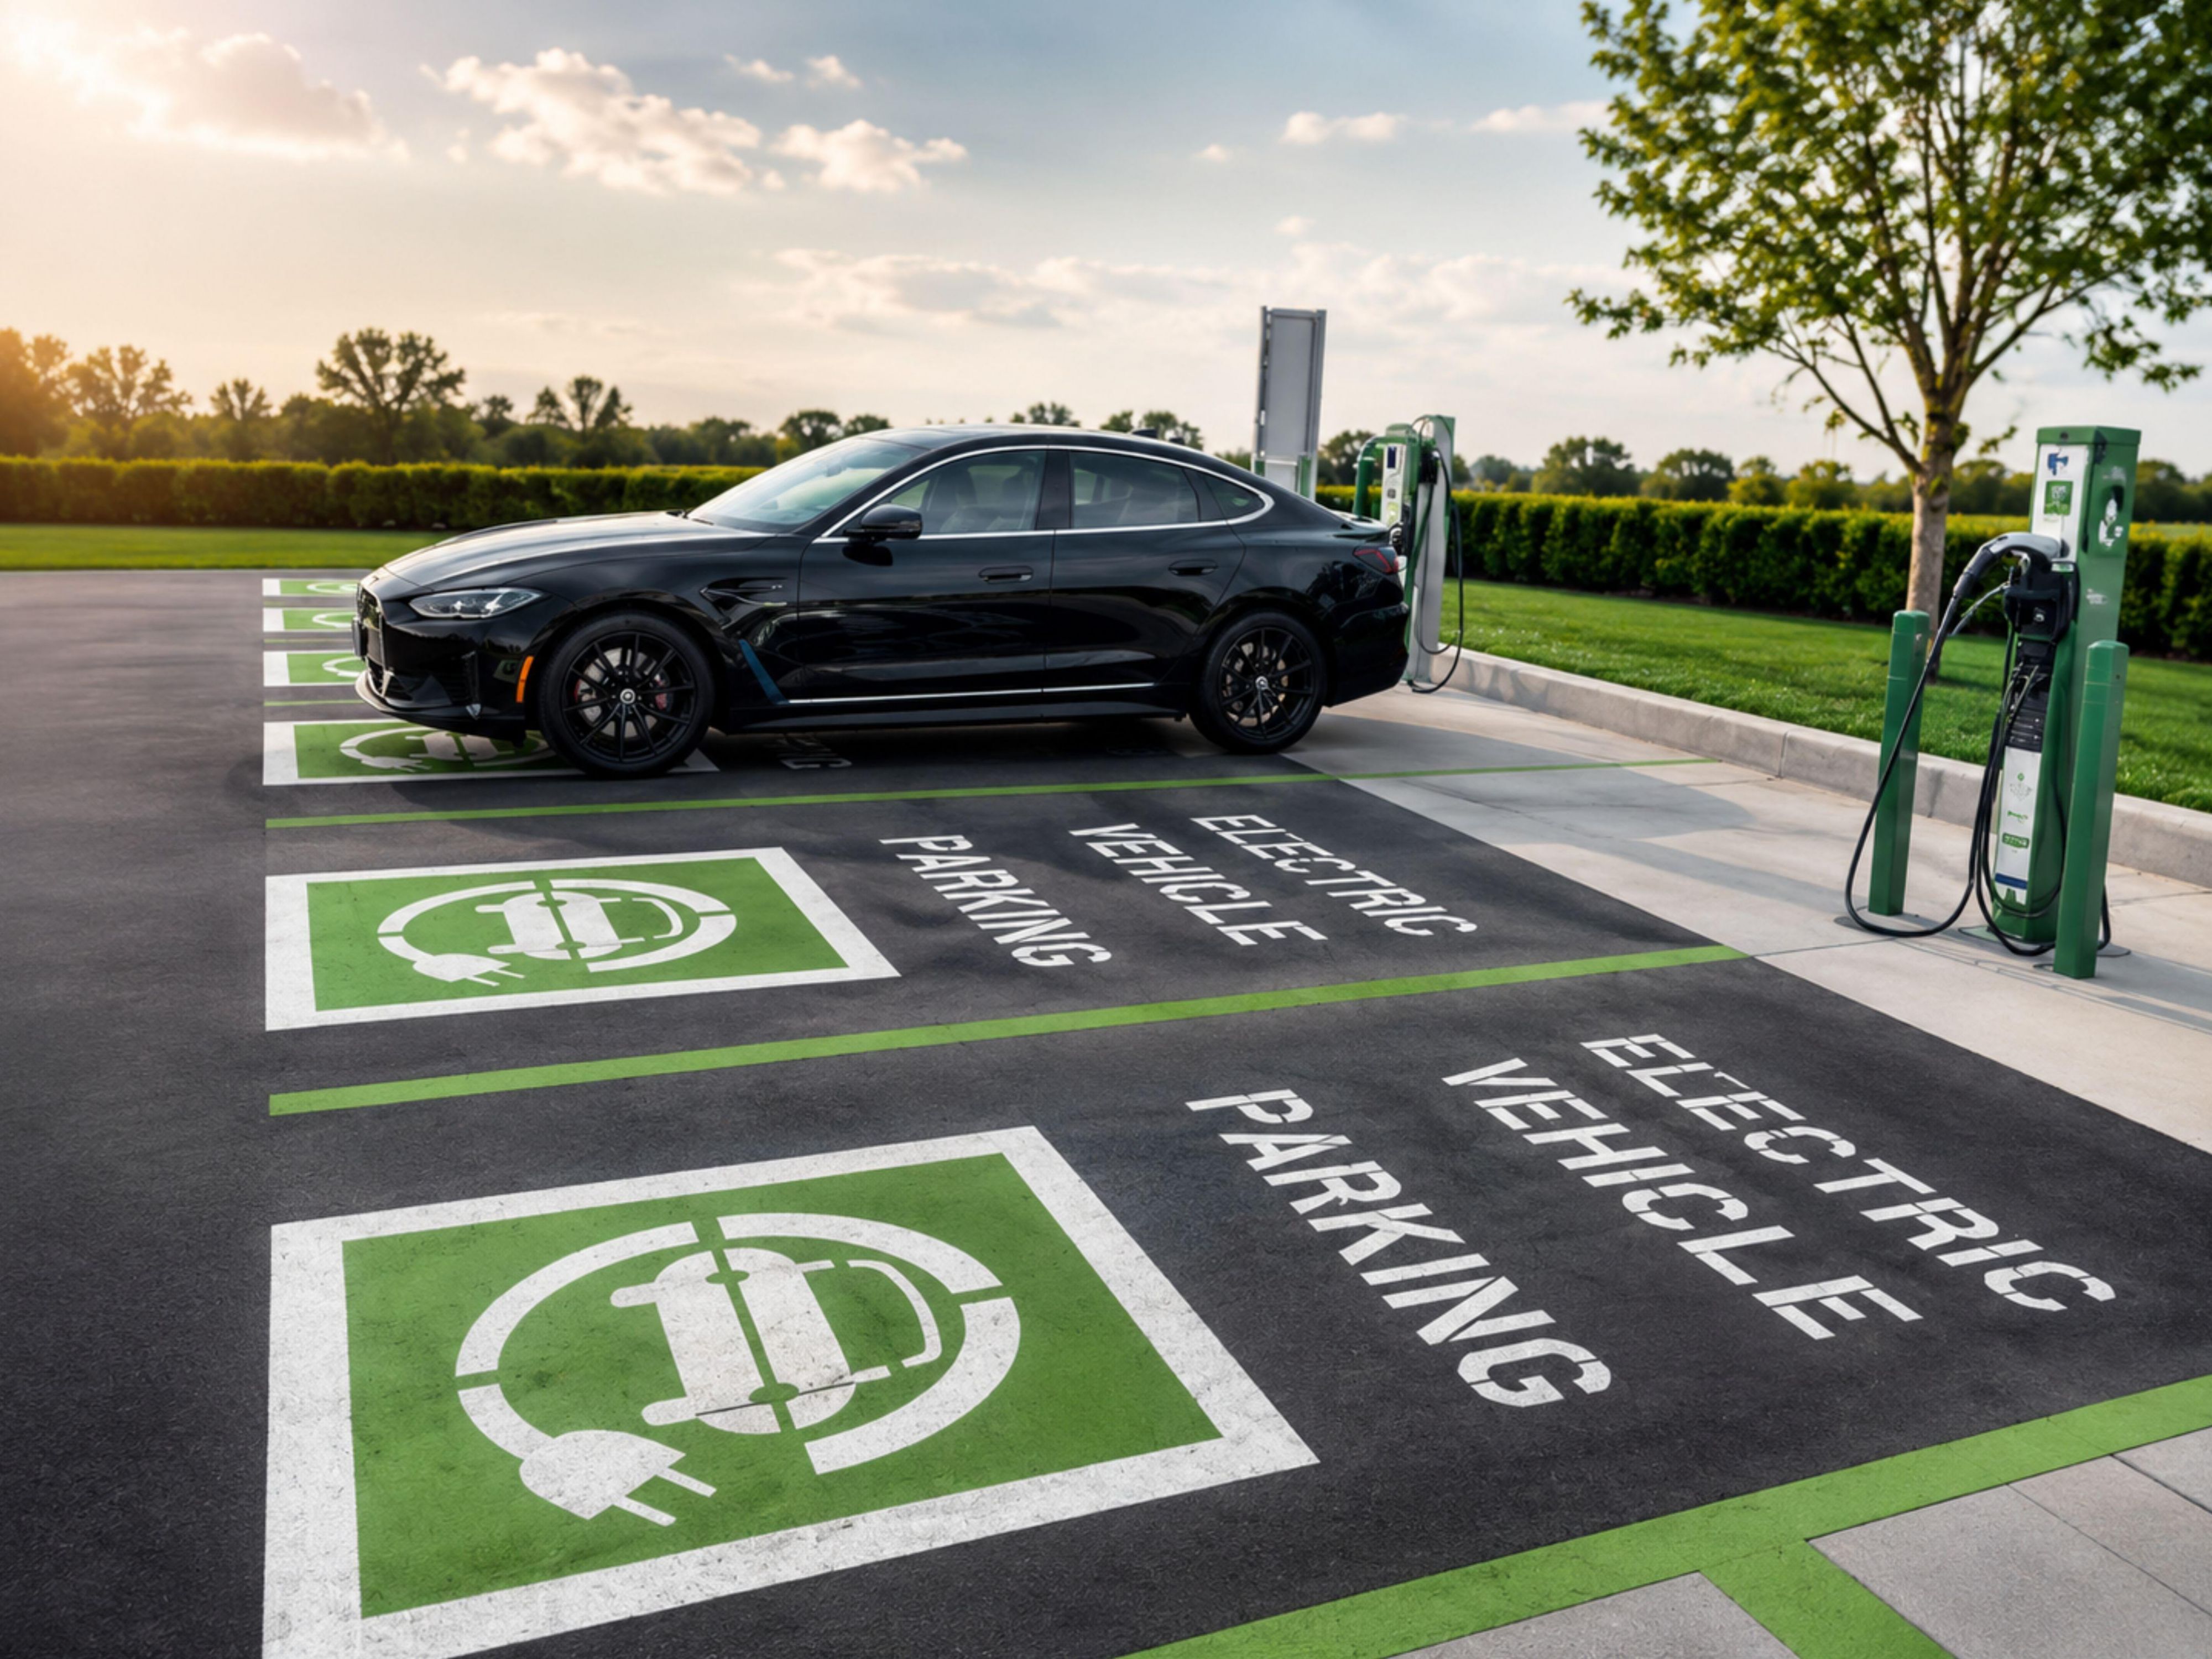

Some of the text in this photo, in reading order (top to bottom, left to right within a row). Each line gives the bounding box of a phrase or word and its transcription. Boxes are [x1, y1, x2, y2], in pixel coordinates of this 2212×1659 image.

[879, 834, 1112, 968] PARKING
[1069, 823, 1328, 946] VEHICLE
[1191, 815, 1478, 936] ELECTRIC
[1185, 1089, 1611, 1408] PARKING
[1442, 1057, 1923, 1340] VEHICLE
[1580, 1033, 2116, 1312] ELECTRIC
